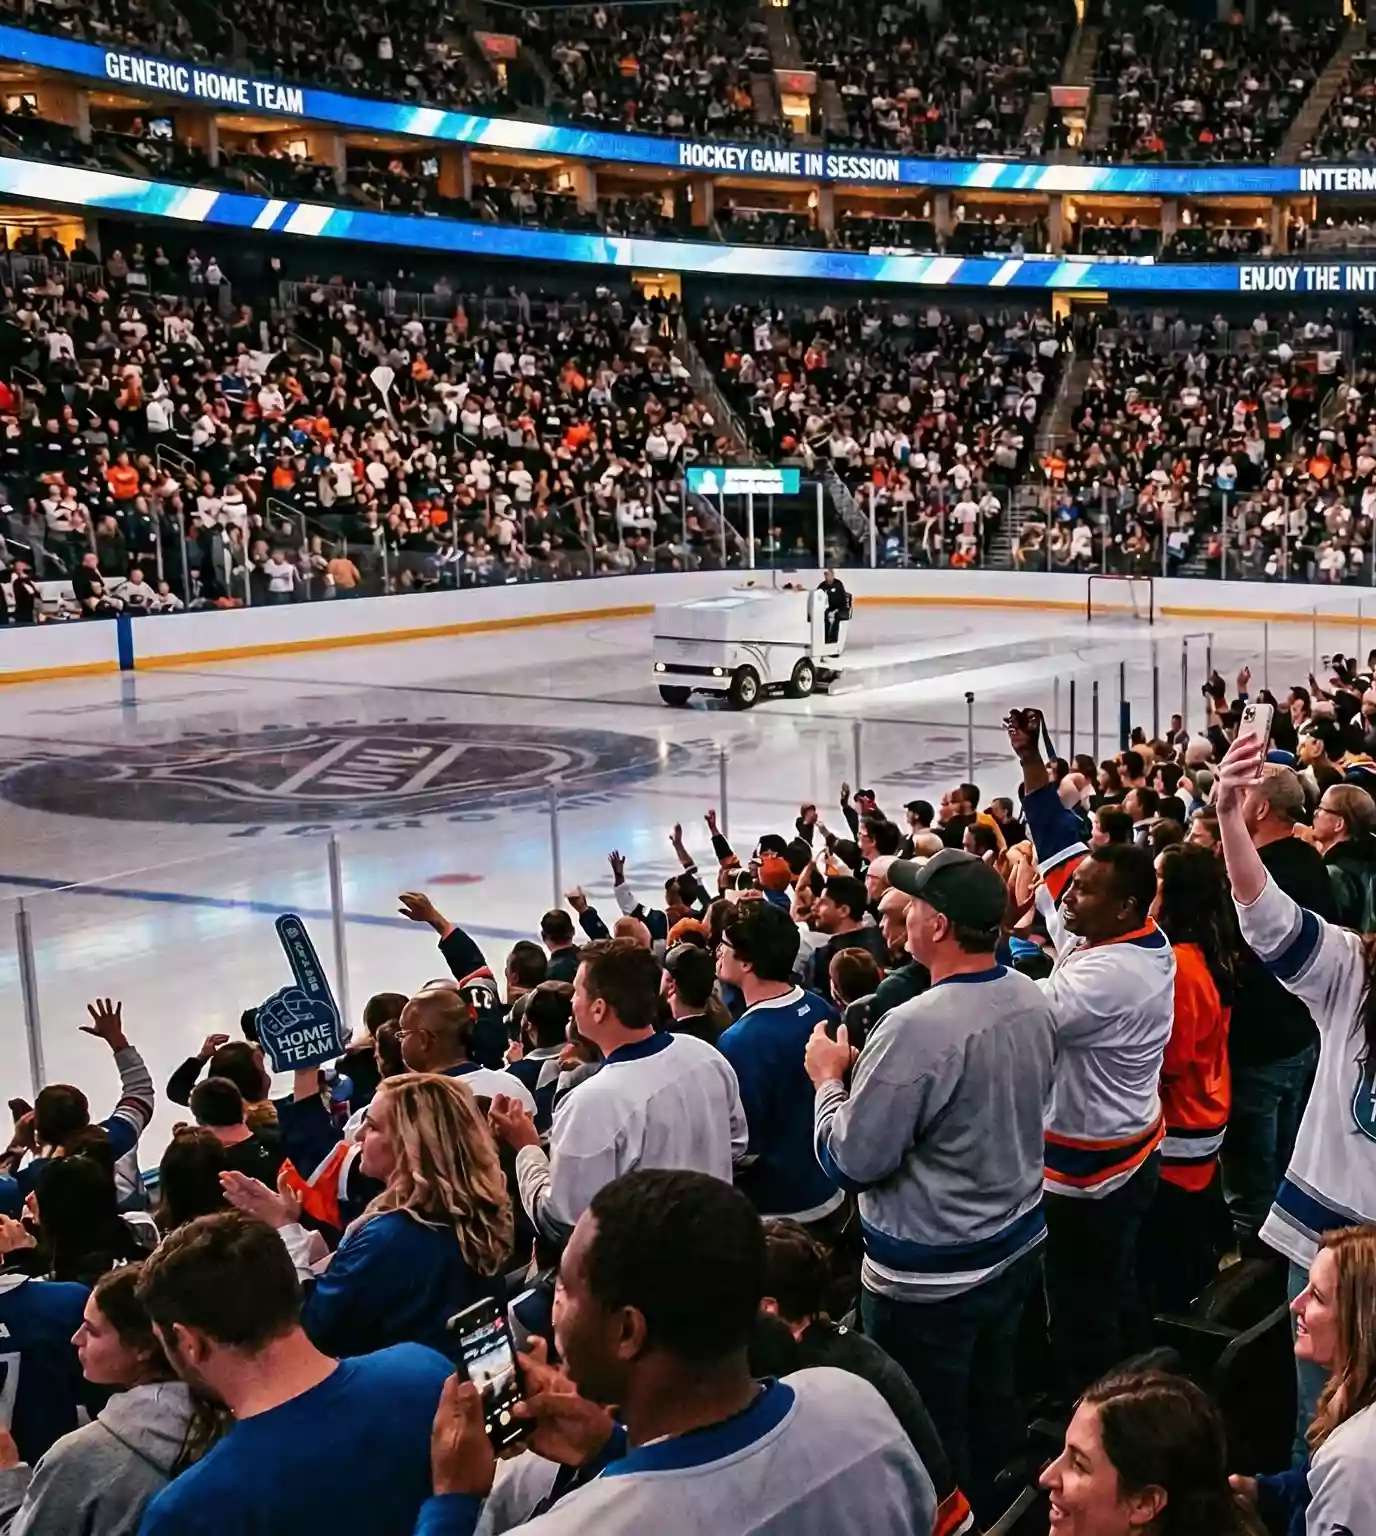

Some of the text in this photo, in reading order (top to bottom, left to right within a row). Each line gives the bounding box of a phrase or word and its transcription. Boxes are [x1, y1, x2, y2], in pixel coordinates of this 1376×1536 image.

[105, 52, 304, 114] GENERIC HOME TEAM
[679, 143, 899, 180] HOCKEY GAME IN SESSION
[1239, 266, 1299, 291] ENJOY
[1304, 266, 1340, 291] THE
[276, 1022, 332, 1050] HOME
[282, 1035, 334, 1063] TEAM
